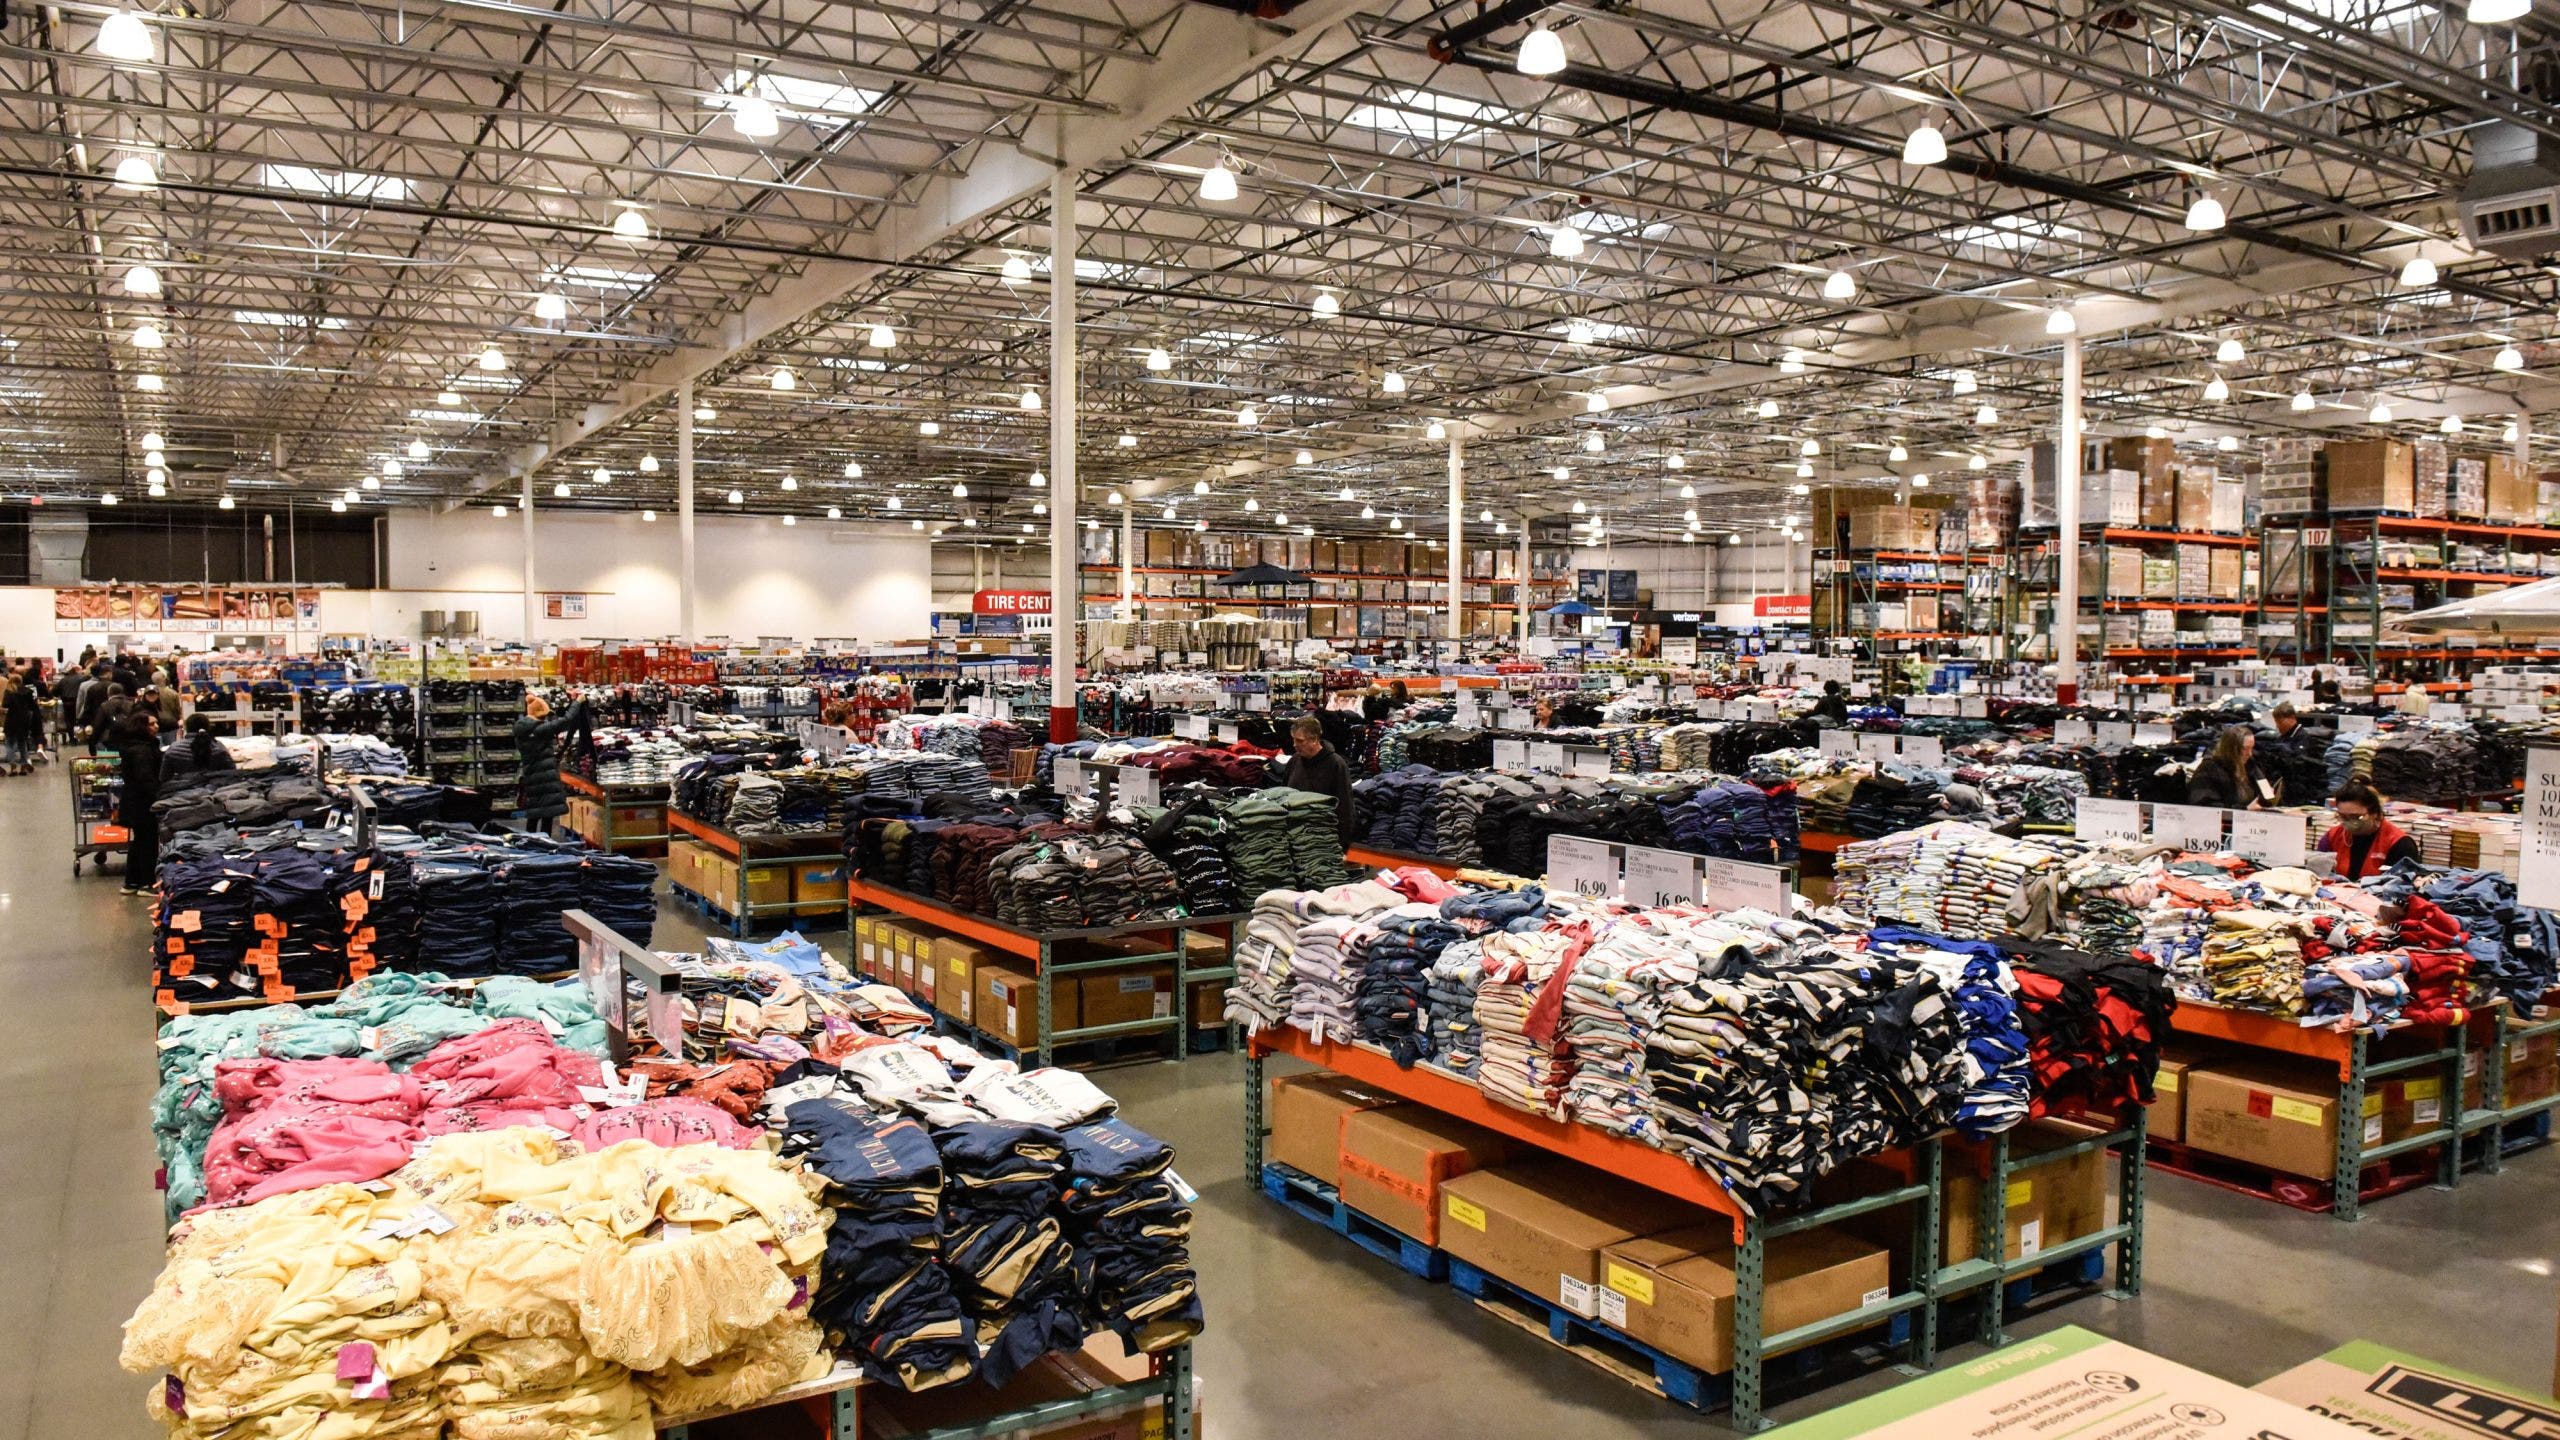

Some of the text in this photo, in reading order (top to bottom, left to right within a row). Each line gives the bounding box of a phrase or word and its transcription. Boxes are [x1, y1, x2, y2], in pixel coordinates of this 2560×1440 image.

[2308, 531, 2327, 544] 107
[1834, 560, 1847, 571] 101
[1991, 556, 2004, 567] 103
[987, 595, 1015, 610] TIRE
[1767, 606, 1792, 614] CONTACT
[1673, 613, 1700, 622] verizon
[206, 621, 219, 629] 1.50
[1834, 749, 1852, 757] 14.99
[1508, 761, 1524, 770] 12.97
[1066, 783, 1081, 794] 23.99
[1131, 795, 1147, 806] 14.99
[2184, 837, 2219, 850] 18.99
[1574, 878, 1607, 896] 16.99
[1563, 1275, 1587, 1292] 1963344
[1601, 1287, 1625, 1304] 1963344
[1865, 1288, 1888, 1302] 1963344
